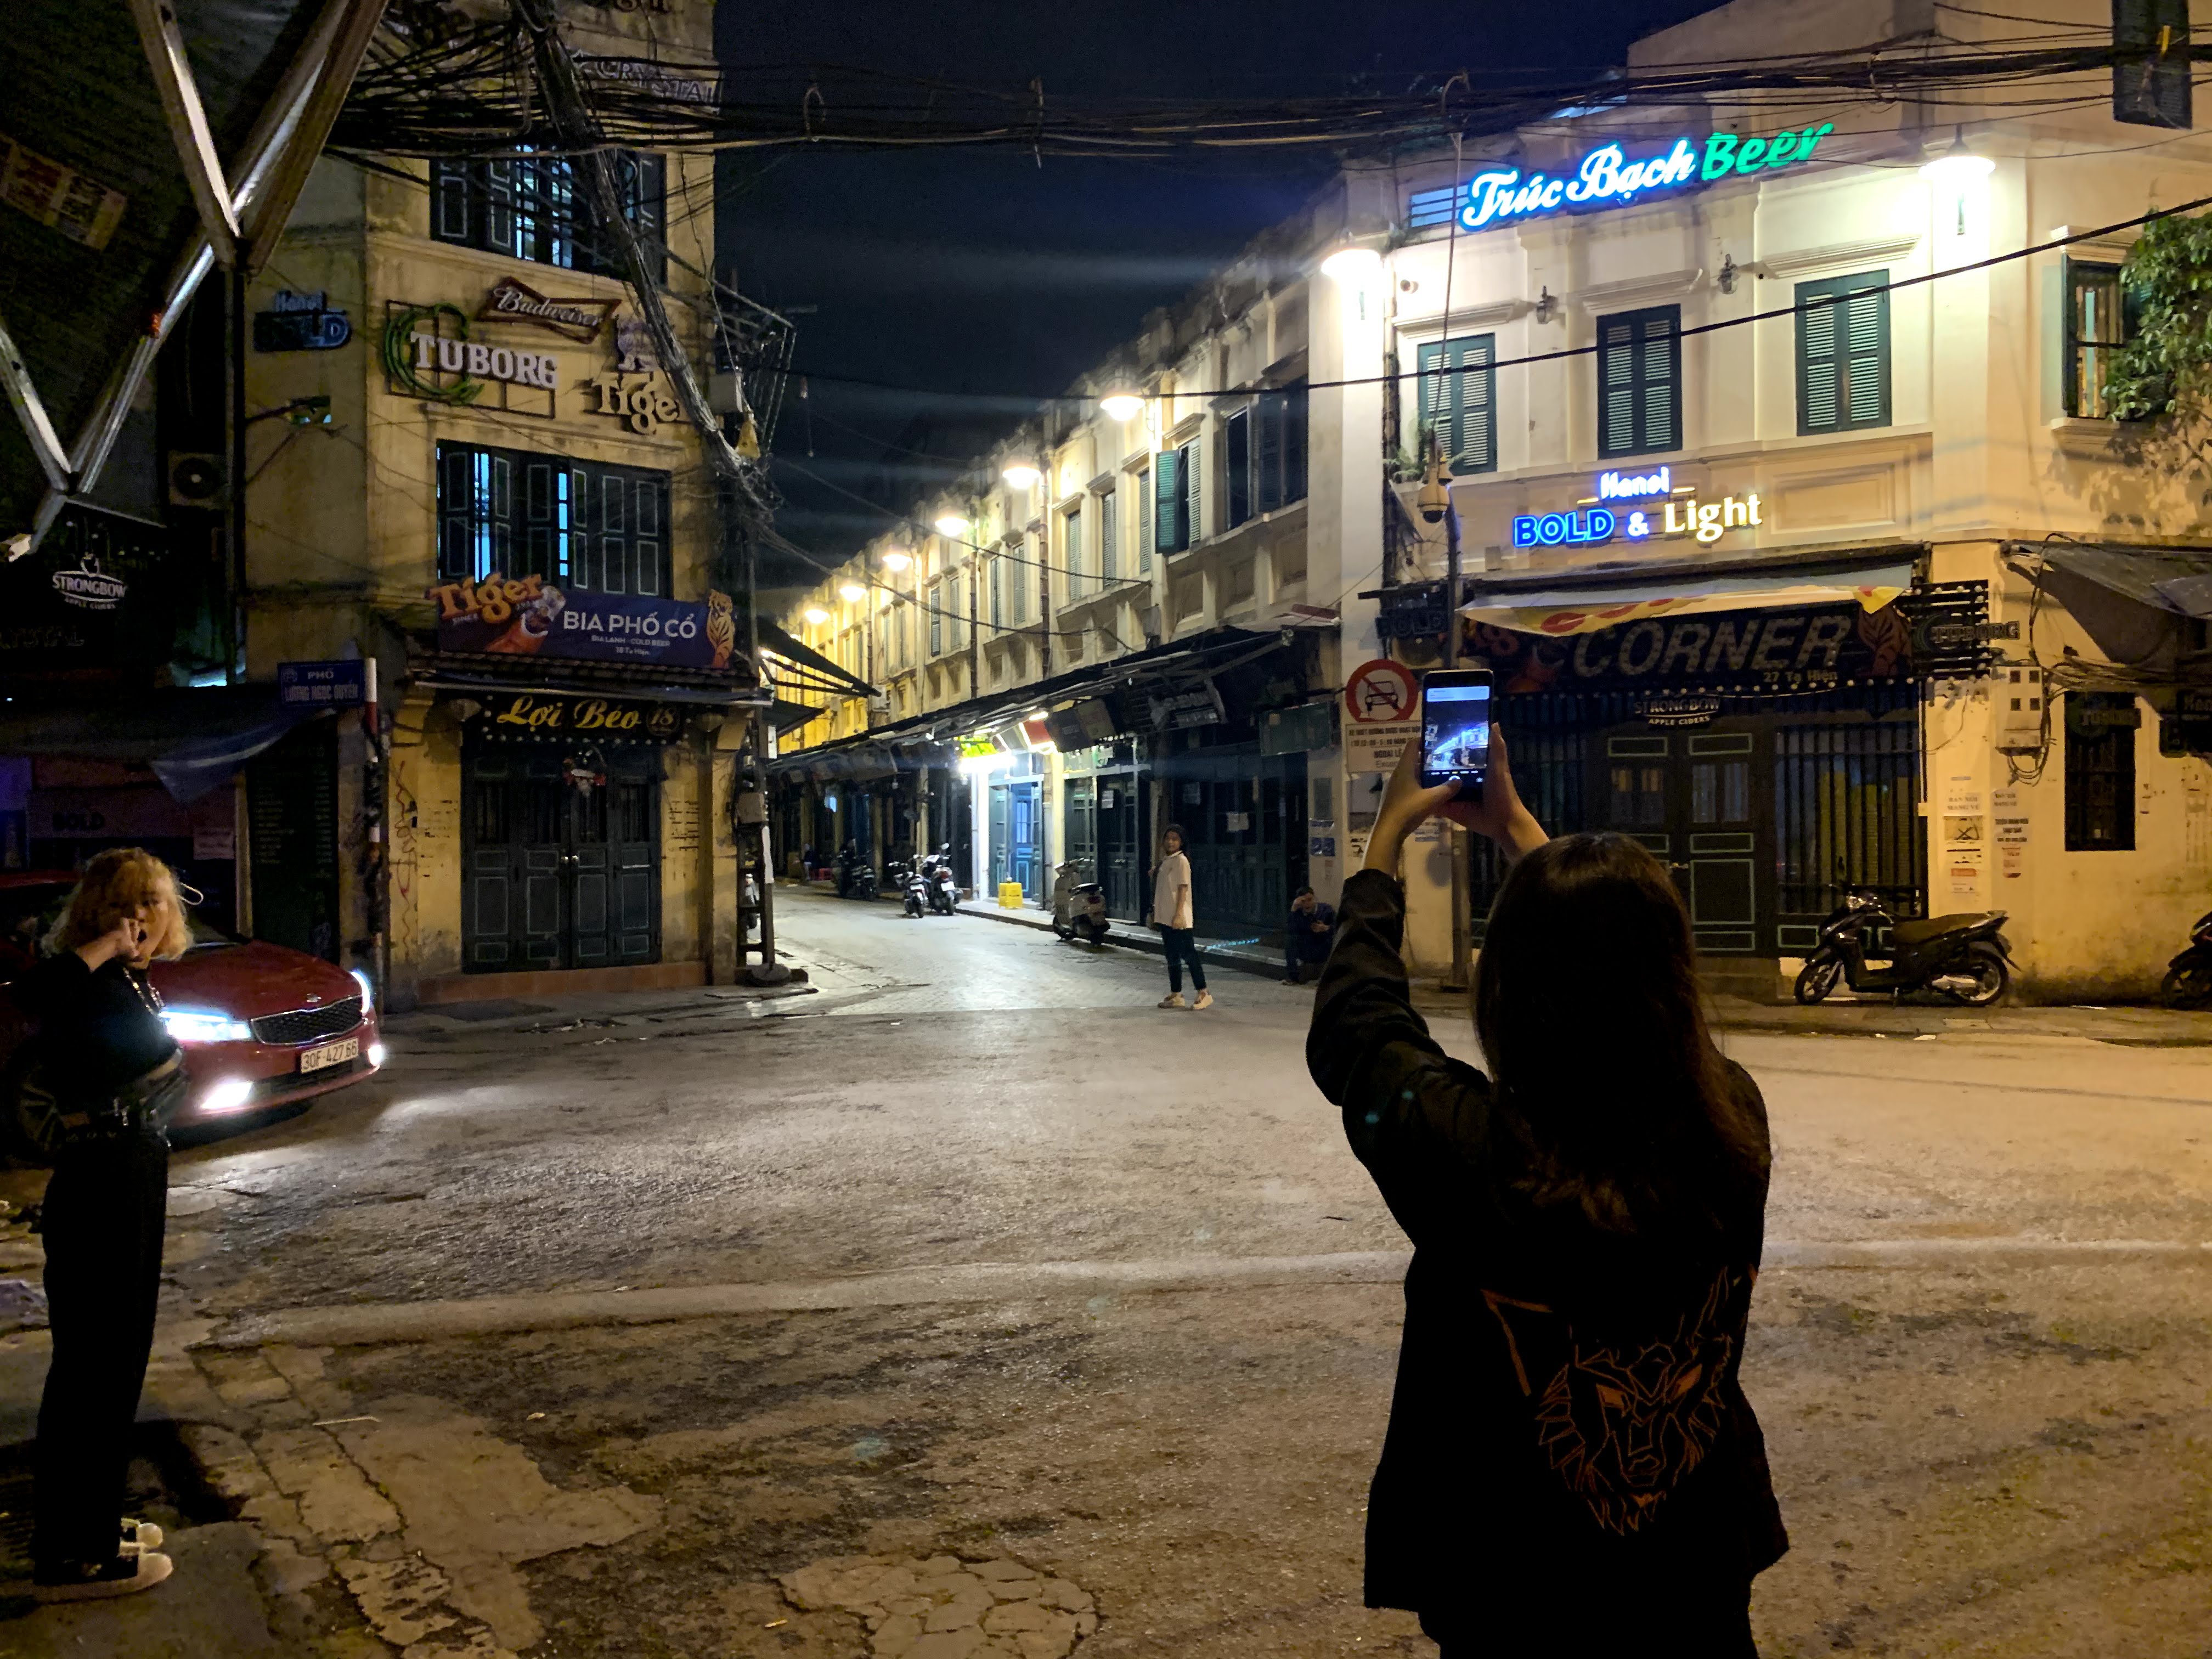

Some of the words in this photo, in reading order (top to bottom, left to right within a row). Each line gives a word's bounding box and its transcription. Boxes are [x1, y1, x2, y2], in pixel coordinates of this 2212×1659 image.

[1462, 170, 1562, 226] Trúc
[1566, 138, 1696, 201] Bạch
[1702, 122, 1834, 180] Beer
[493, 287, 603, 328] Budweiser
[255, 312, 351, 350] LD
[410, 331, 559, 388] TUBORG
[1600, 466, 1669, 500] Hanoi
[1513, 509, 1615, 548] BOLD
[1627, 512, 1649, 537] &
[1664, 494, 1763, 542] Light
[53, 576, 129, 597] STRONGBOW
[427, 572, 541, 623] Tiger
[563, 611, 604, 631] BIA
[608, 611, 660, 635] PHỐ
[664, 613, 696, 639] CỔ
[1930, 620, 2021, 644] TUBORG
[1572, 616, 1852, 678] CORNER
[1763, 671, 1780, 683] 27
[496, 695, 563, 732] Lợi
[574, 699, 641, 729] Béo
[1634, 697, 1720, 714] STRONGBOW
